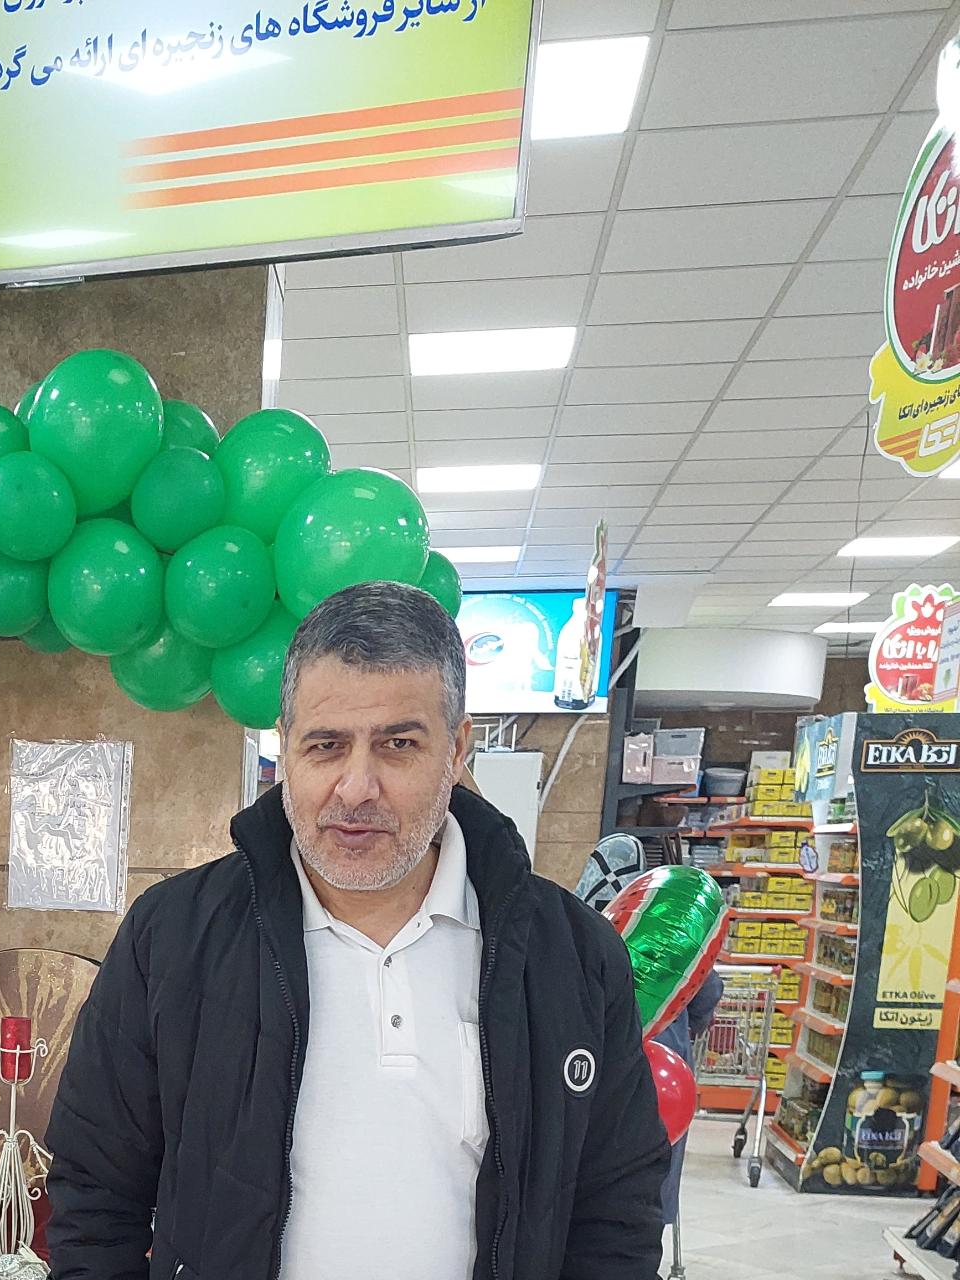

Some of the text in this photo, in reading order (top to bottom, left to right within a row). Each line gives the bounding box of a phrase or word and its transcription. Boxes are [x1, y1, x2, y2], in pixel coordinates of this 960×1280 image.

[152, 21, 225, 67] زنجیره
[230, 9, 283, 56] های
[69, 33, 114, 77] ارائه
[118, 28, 148, 72] ای
[30, 55, 64, 86] می
[902, 260, 939, 291] خانواده
[898, 404, 914, 420] اتکا
[866, 744, 917, 765] ETKA
[882, 990, 936, 1000] ETKA Olive
[879, 1010, 933, 1027] زیتون اتکا
